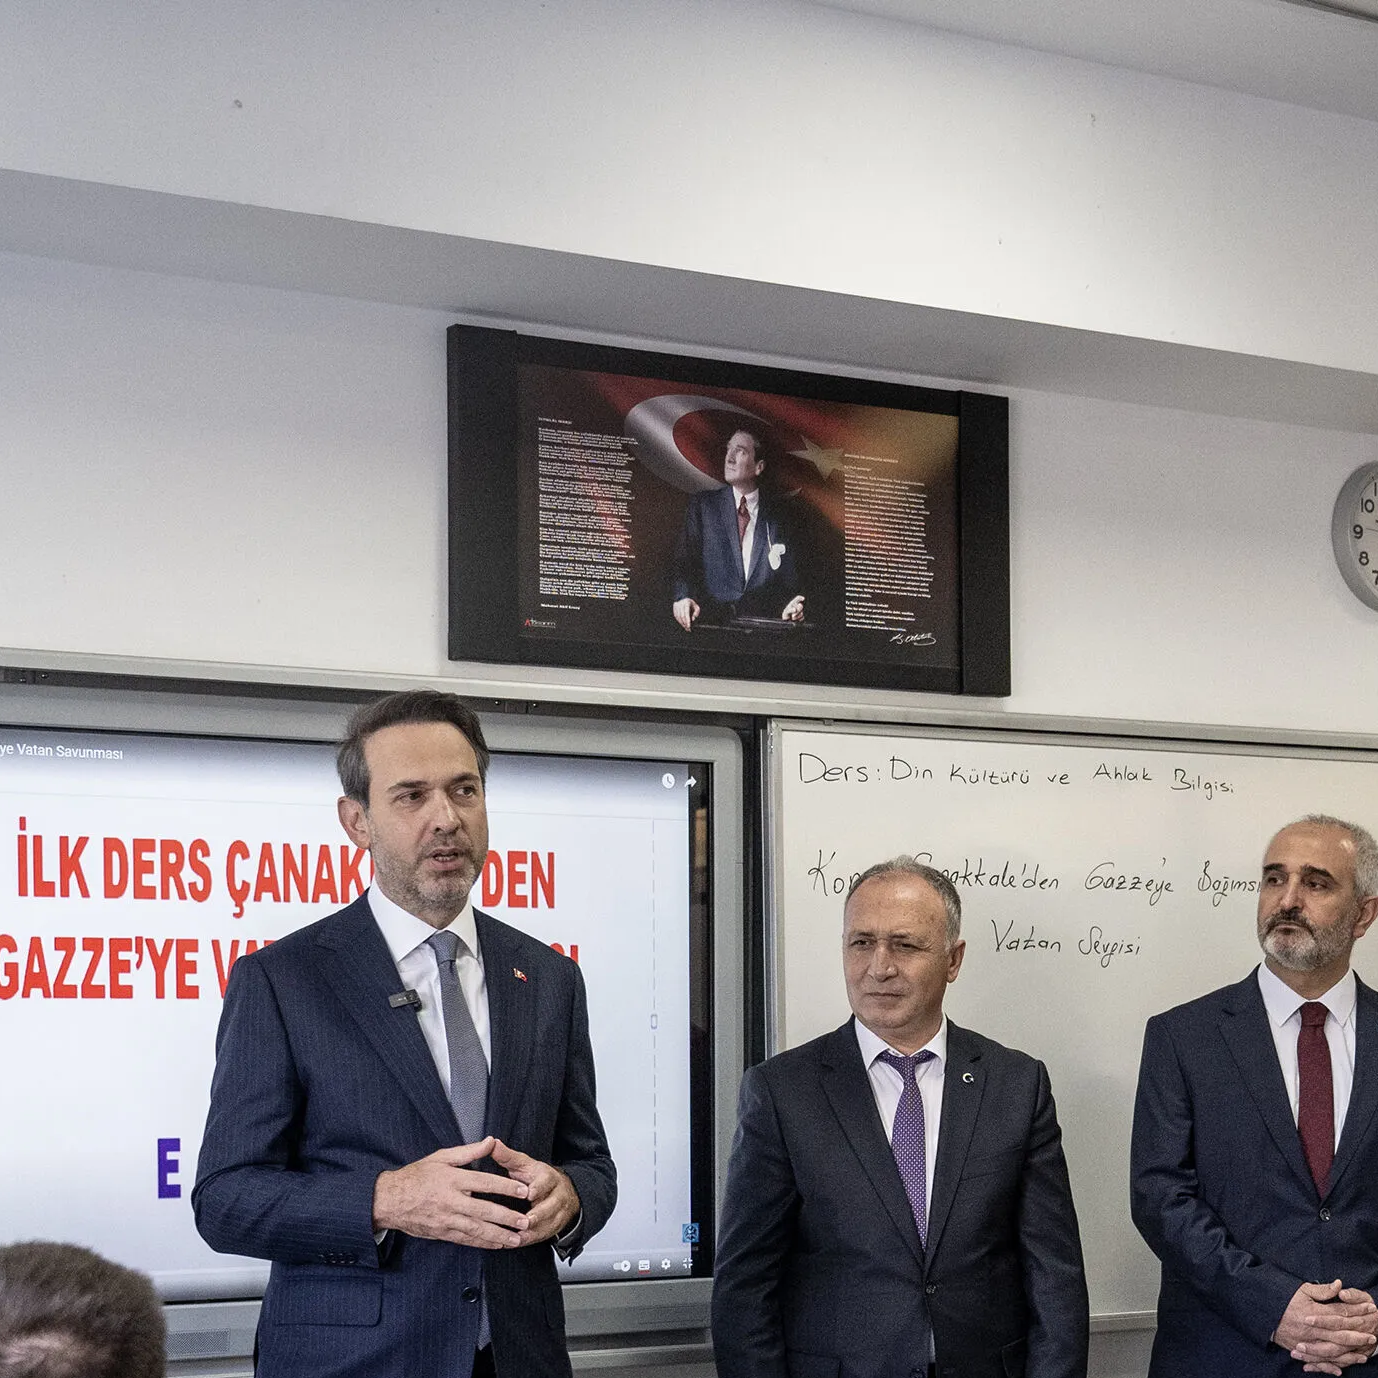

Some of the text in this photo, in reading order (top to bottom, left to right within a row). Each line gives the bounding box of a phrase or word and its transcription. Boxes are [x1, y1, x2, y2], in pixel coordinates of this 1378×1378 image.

[1360, 498, 1375, 514] 10
[1353, 524, 1363, 540] 9
[1358, 551, 1370, 566] 8
[17, 743, 53, 757] Vatan
[56, 745, 123, 760] Savunması
[889, 755, 933, 780] Din
[950, 763, 1030, 785] Kültürü
[1047, 772, 1071, 785] ve
[1093, 763, 1153, 782] Ahlak
[1171, 768, 1235, 800] Bilgisi
[17, 816, 91, 898] İLK
[103, 838, 212, 903] DERS
[991, 919, 1061, 952] Vatan
